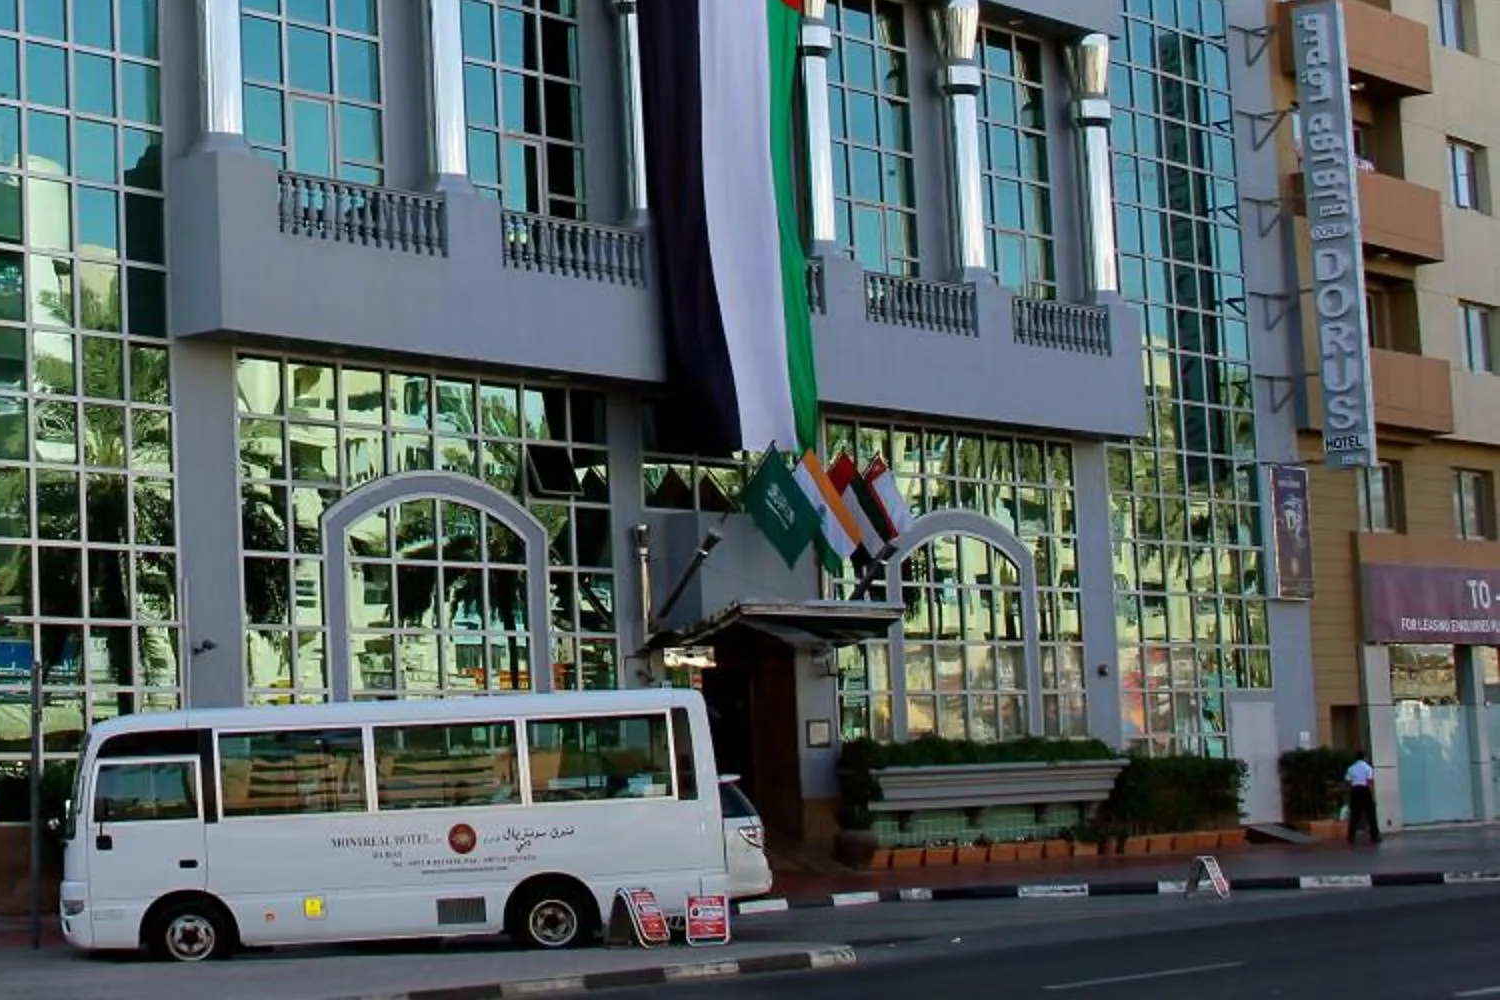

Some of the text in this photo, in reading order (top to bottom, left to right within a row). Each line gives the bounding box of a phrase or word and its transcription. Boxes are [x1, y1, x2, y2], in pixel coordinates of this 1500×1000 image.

[1297, 11, 1334, 101] فندق
[1314, 248, 1358, 431] DORUS
[1325, 434, 1365, 451] HOTEL
[1466, 579, 1491, 609] TO
[1401, 616, 1417, 632] FOR
